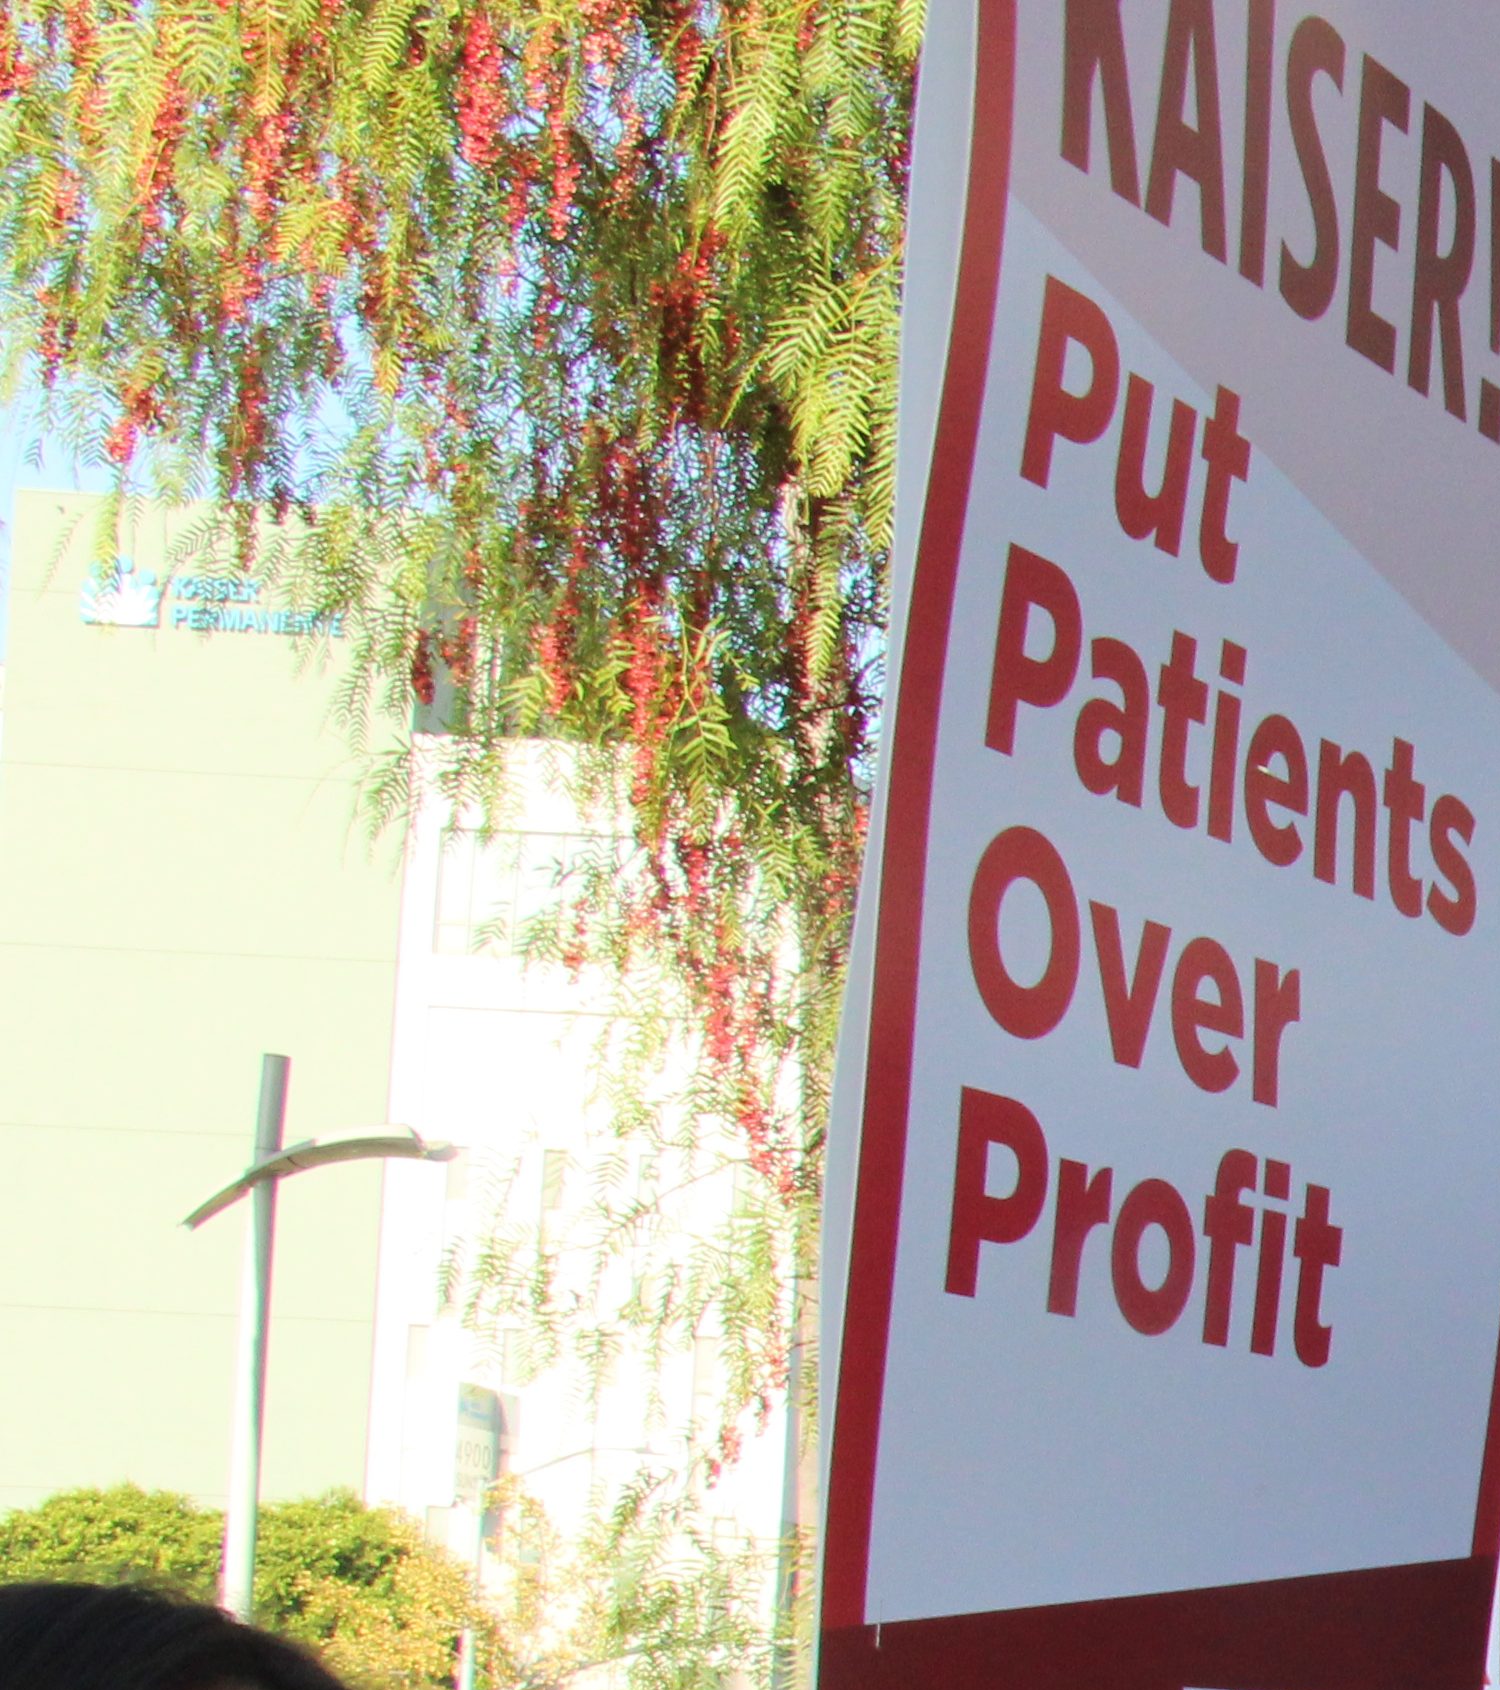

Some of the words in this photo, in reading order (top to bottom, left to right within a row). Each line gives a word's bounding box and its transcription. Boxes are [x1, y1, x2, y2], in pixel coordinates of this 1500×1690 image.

[1019, 273, 1251, 585] Put
[984, 542, 1477, 936] Patients
[967, 825, 1301, 1108] Over
[944, 1085, 1343, 1368] Profit
